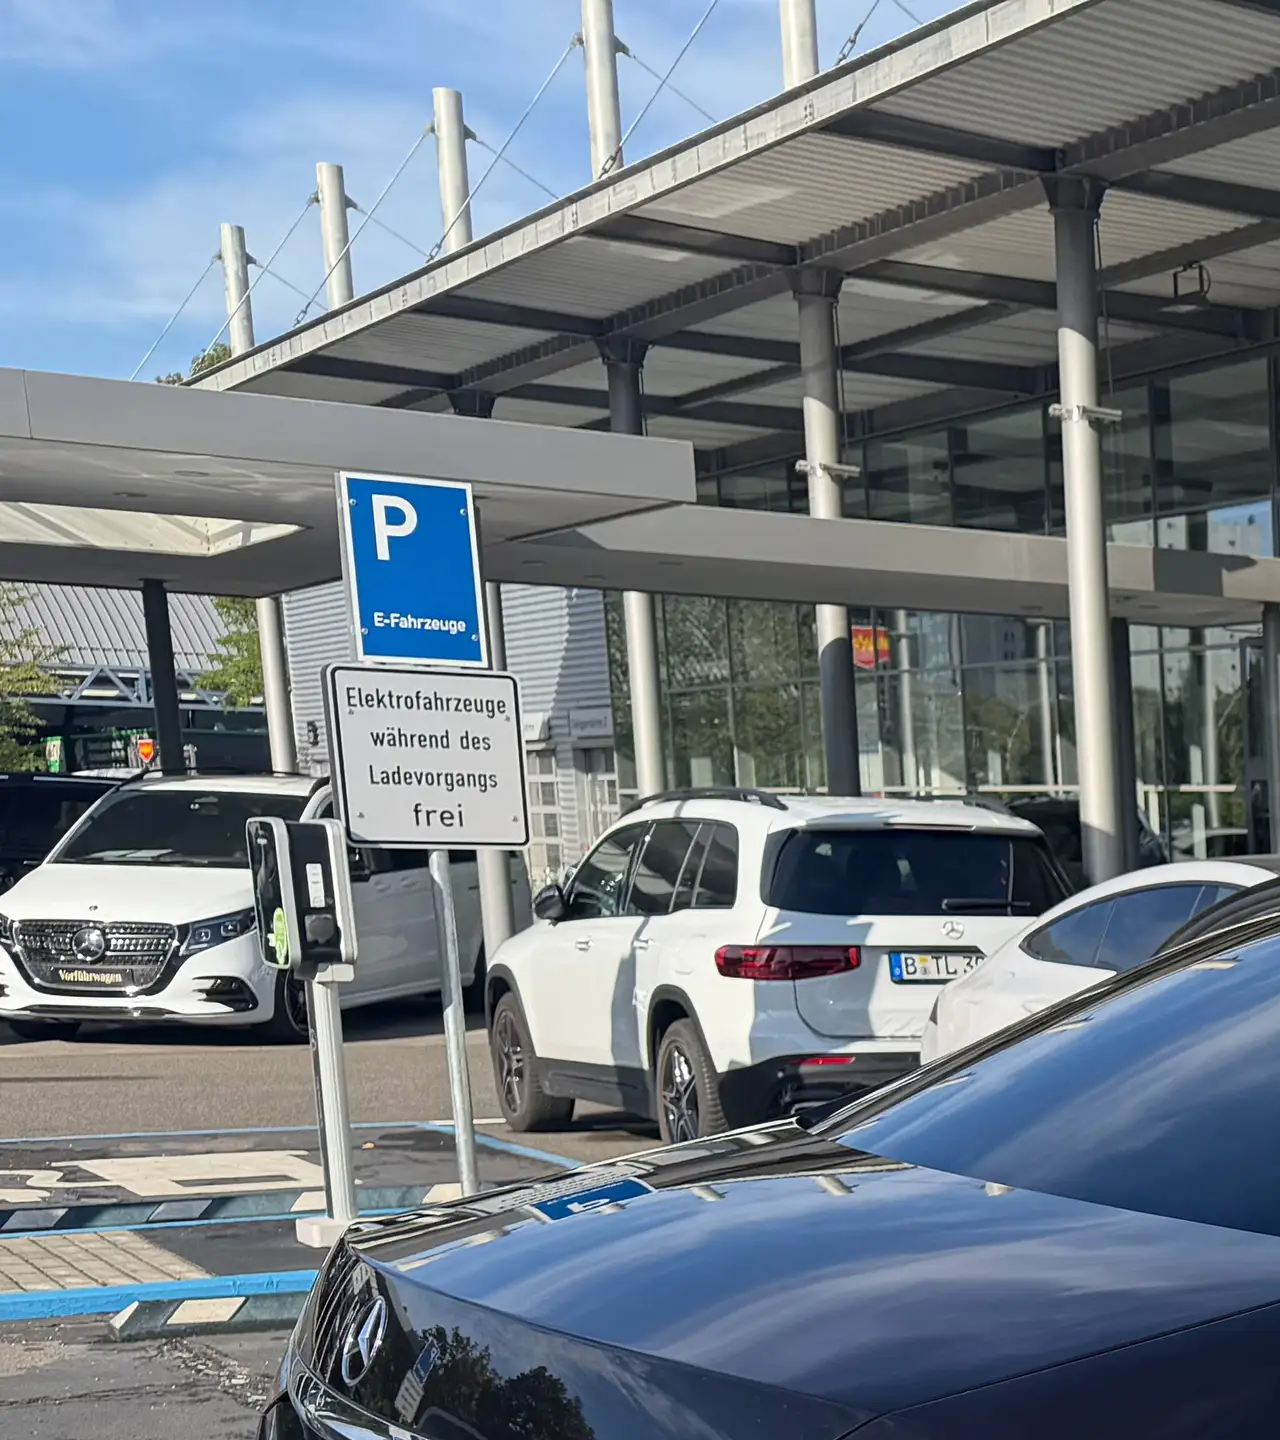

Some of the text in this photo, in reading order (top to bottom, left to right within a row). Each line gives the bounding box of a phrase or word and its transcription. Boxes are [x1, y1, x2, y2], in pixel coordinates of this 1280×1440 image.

[372, 493, 418, 561] P
[373, 611, 467, 635] E-Fahrzeuge
[346, 687, 506, 719] Elektrofahrzeuge
[370, 726, 492, 751] während des
[369, 764, 499, 793] Ladevorgangs
[413, 802, 464, 828] frei
[58, 968, 122, 985] Vorführwagen
[904, 956, 918, 975] B
[931, 955, 958, 976] TL
